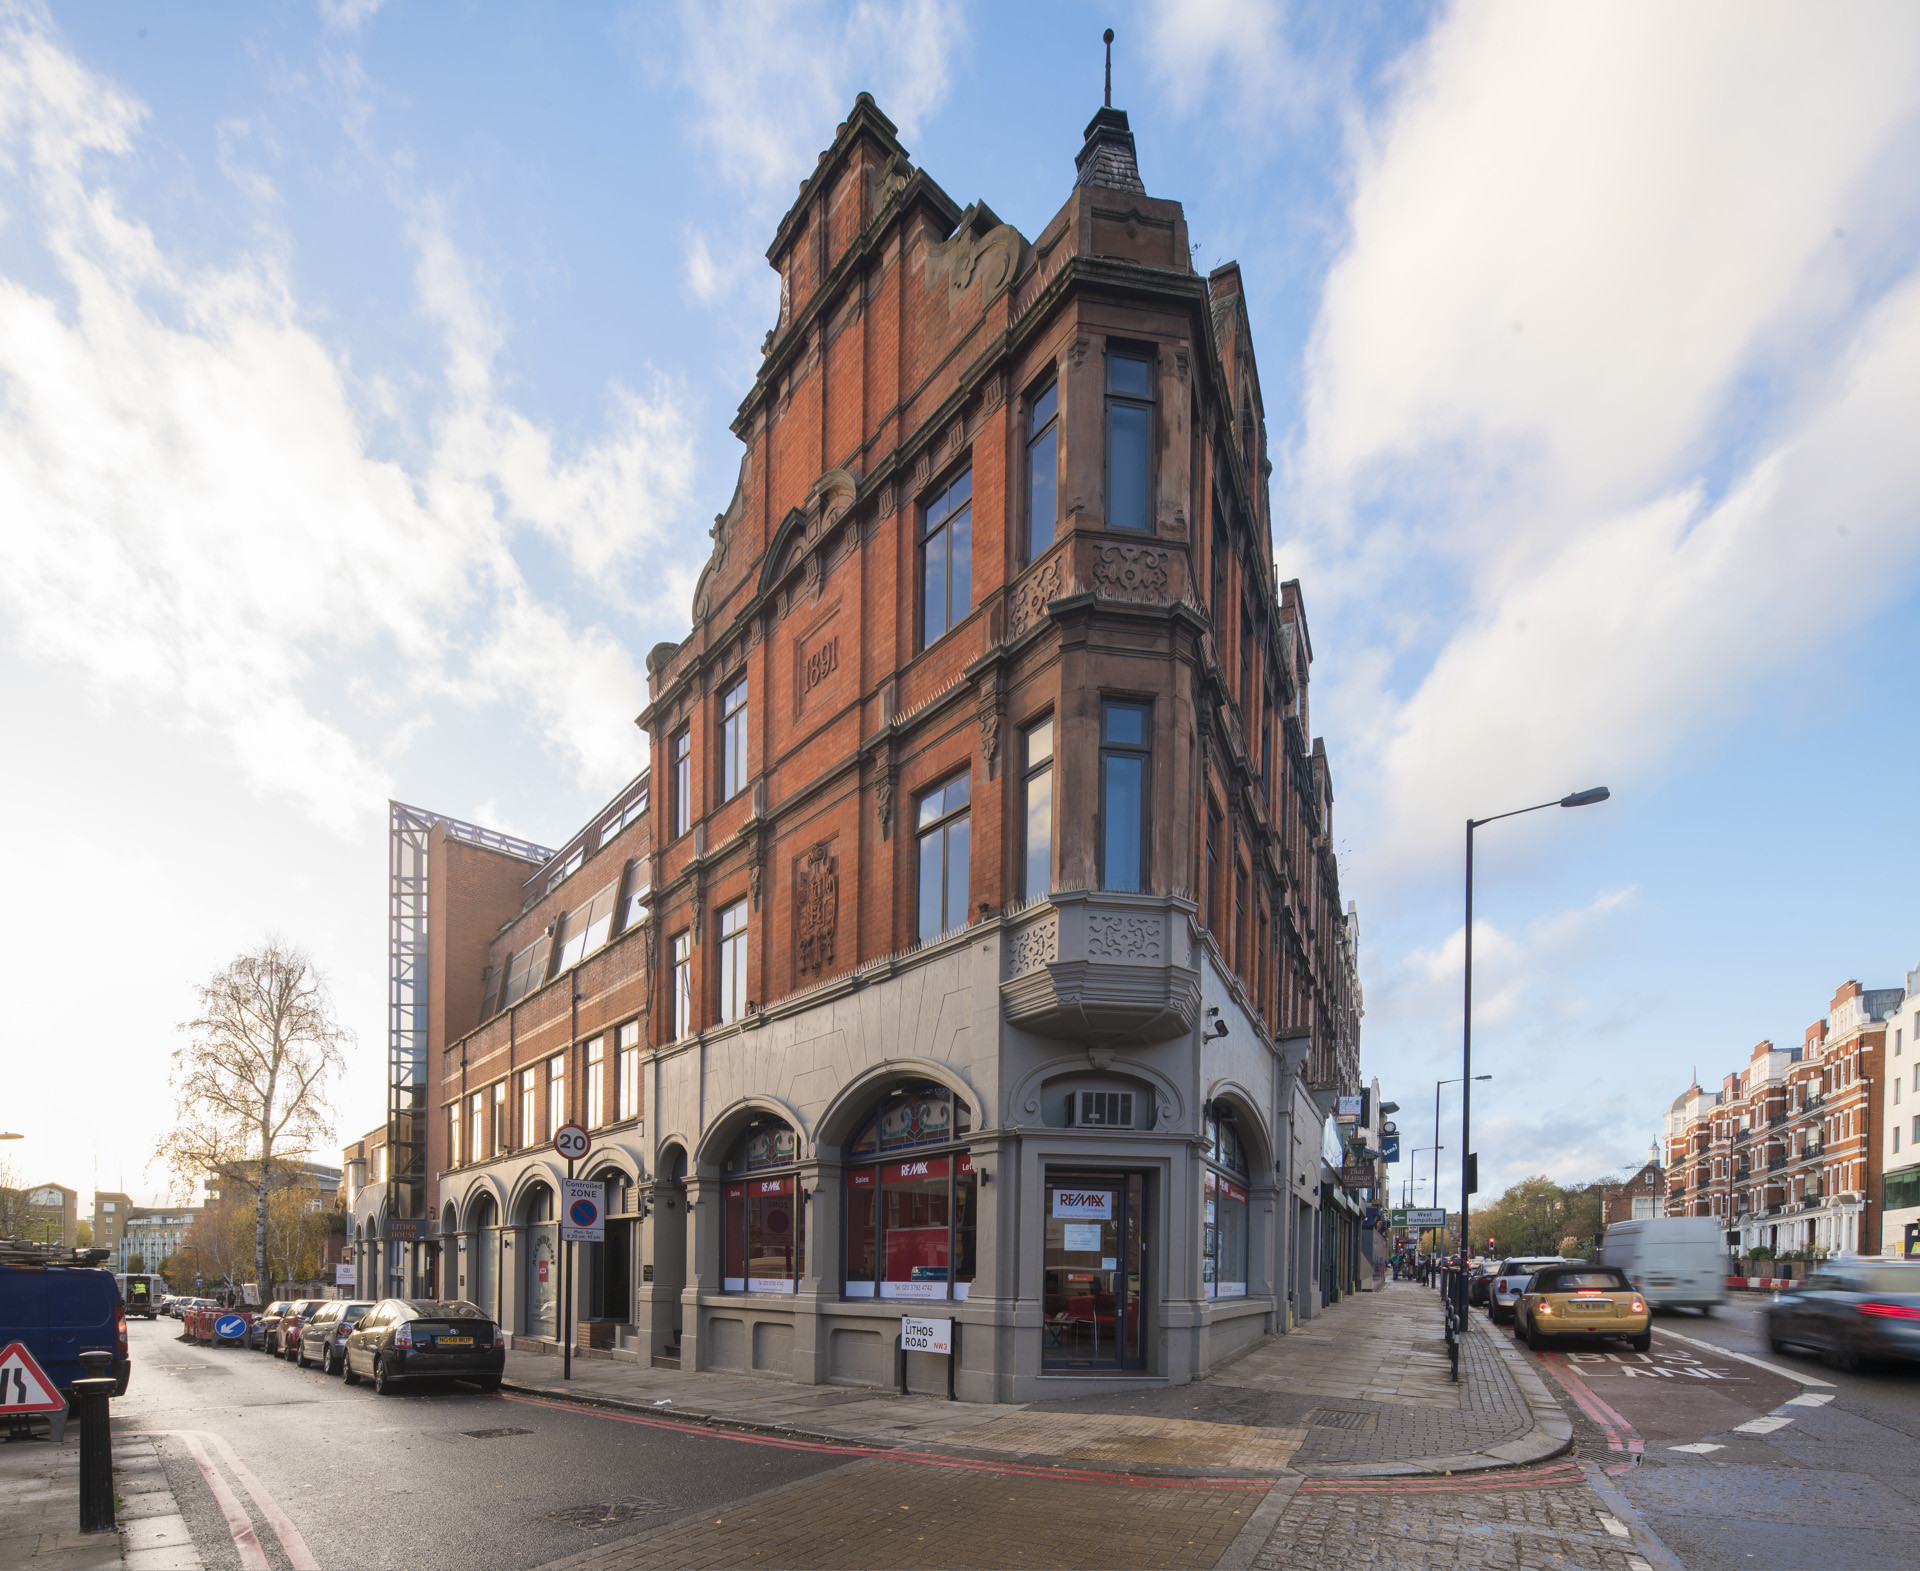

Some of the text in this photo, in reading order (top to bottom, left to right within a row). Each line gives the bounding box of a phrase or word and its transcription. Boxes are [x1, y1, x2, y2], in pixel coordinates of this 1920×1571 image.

[802, 636, 839, 695] 1891
[559, 1133, 586, 1151] 20
[1348, 1167, 1365, 1175] Thai
[565, 1180, 603, 1190] Controlled
[855, 1176, 869, 1184] Sales
[570, 1189, 597, 1198] ZONE
[391, 1223, 417, 1231] LITHOS
[905, 1325, 934, 1337] LITHOS
[905, 1337, 948, 1351] ROAD NW3
[1566, 1352, 1704, 1366] BUS
[1567, 1364, 1750, 1380] LANE
